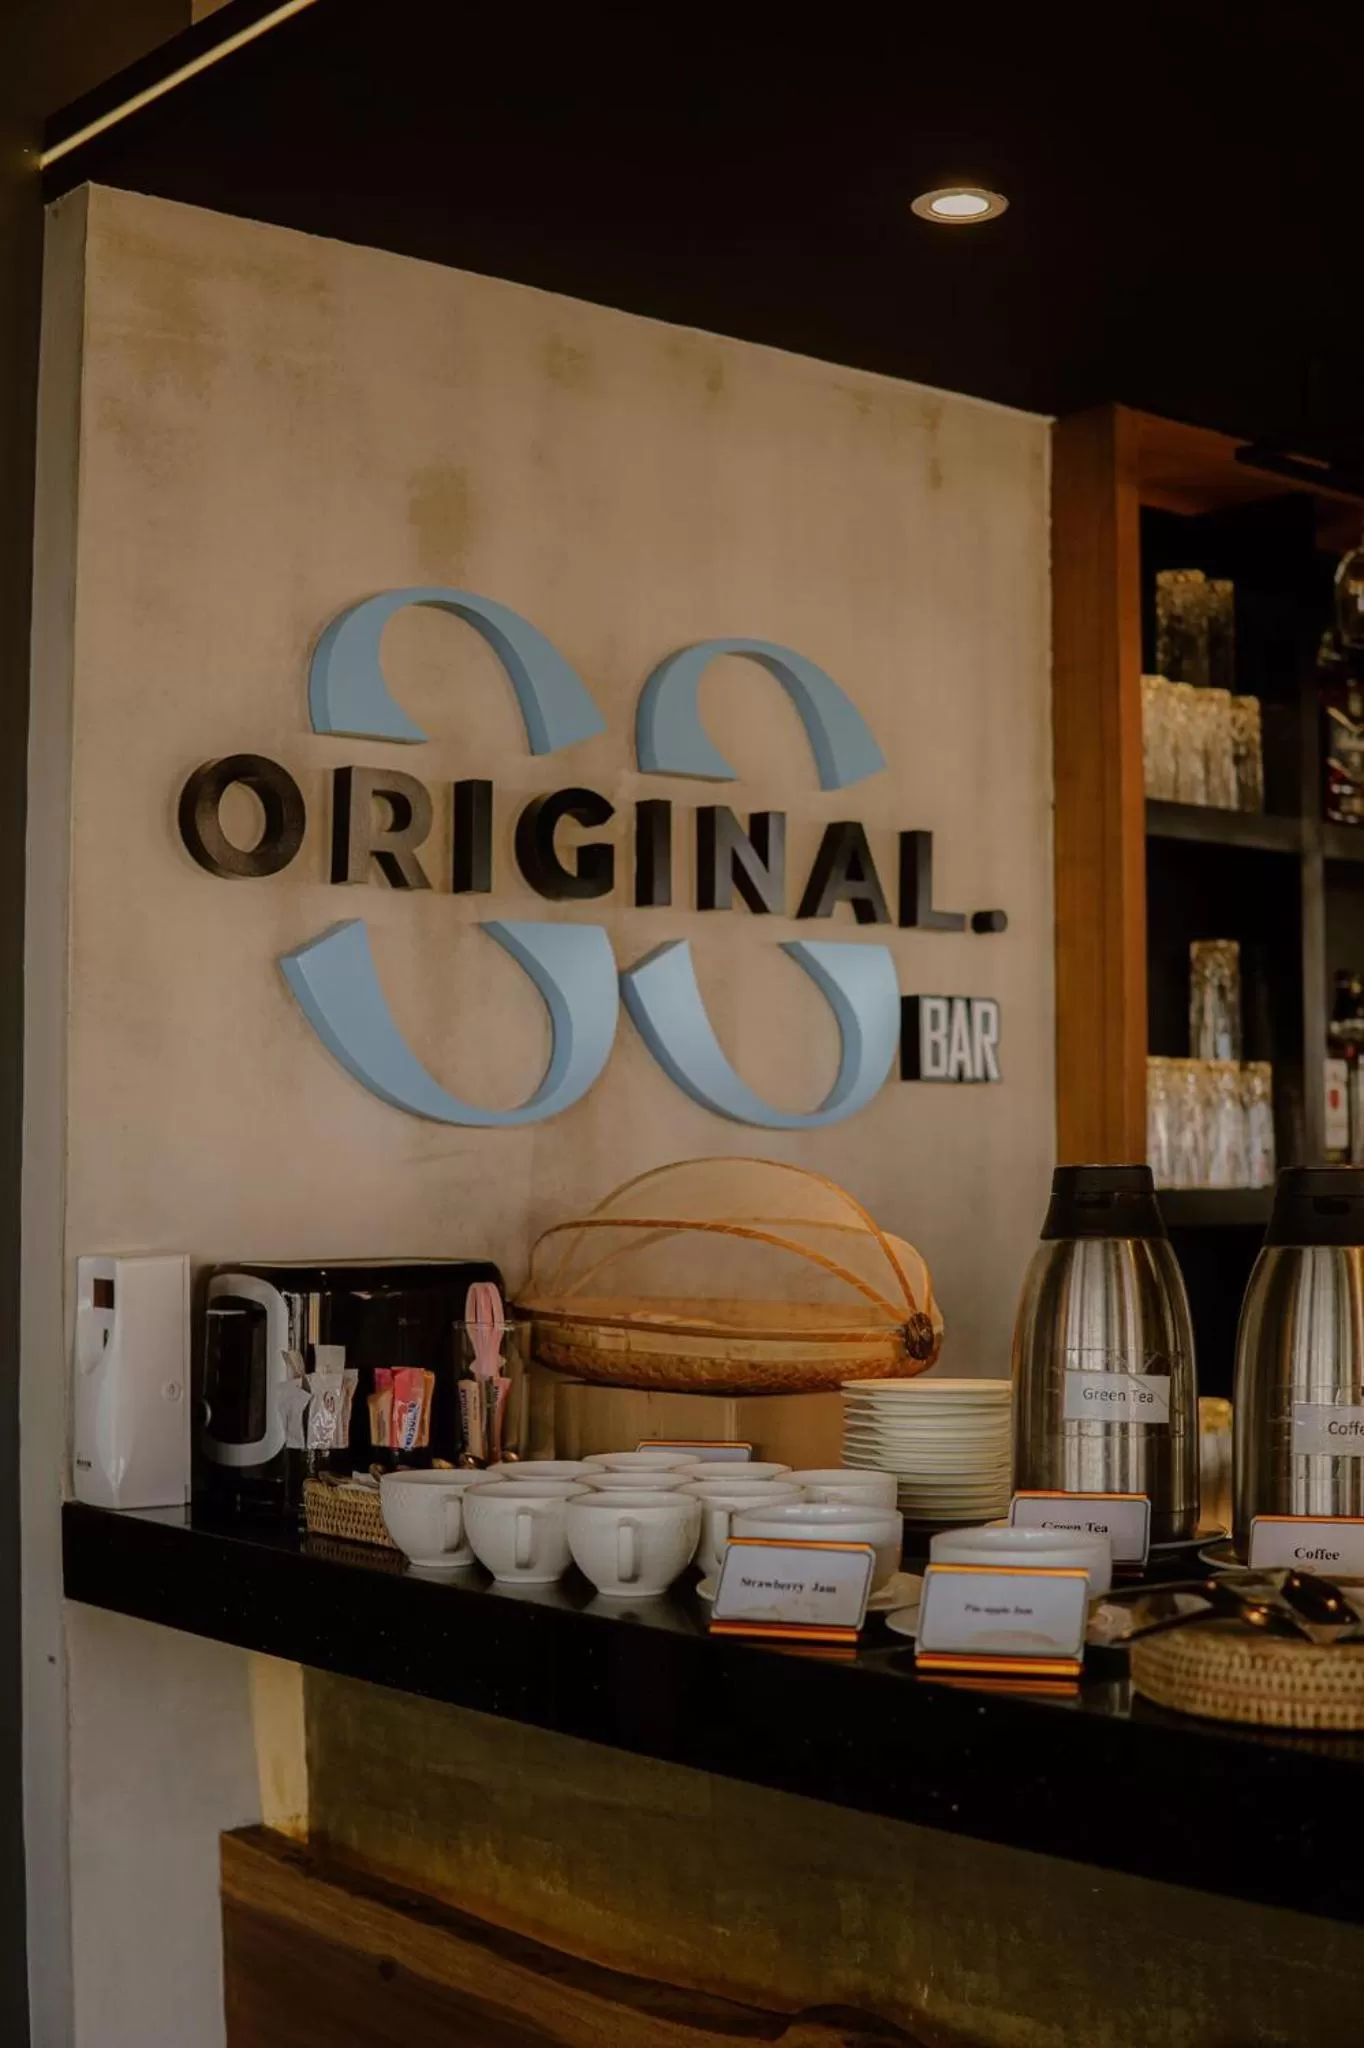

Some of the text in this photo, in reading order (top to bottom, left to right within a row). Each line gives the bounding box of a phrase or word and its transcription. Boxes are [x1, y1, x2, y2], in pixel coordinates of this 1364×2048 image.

[912, 996, 1001, 1082] BAR
[1082, 1386, 1154, 1404] Green Tea
[1085, 1522, 1109, 1533] Tea
[1294, 1547, 1340, 1561] Coffee
[740, 1576, 836, 1594] Strawberry Jam
